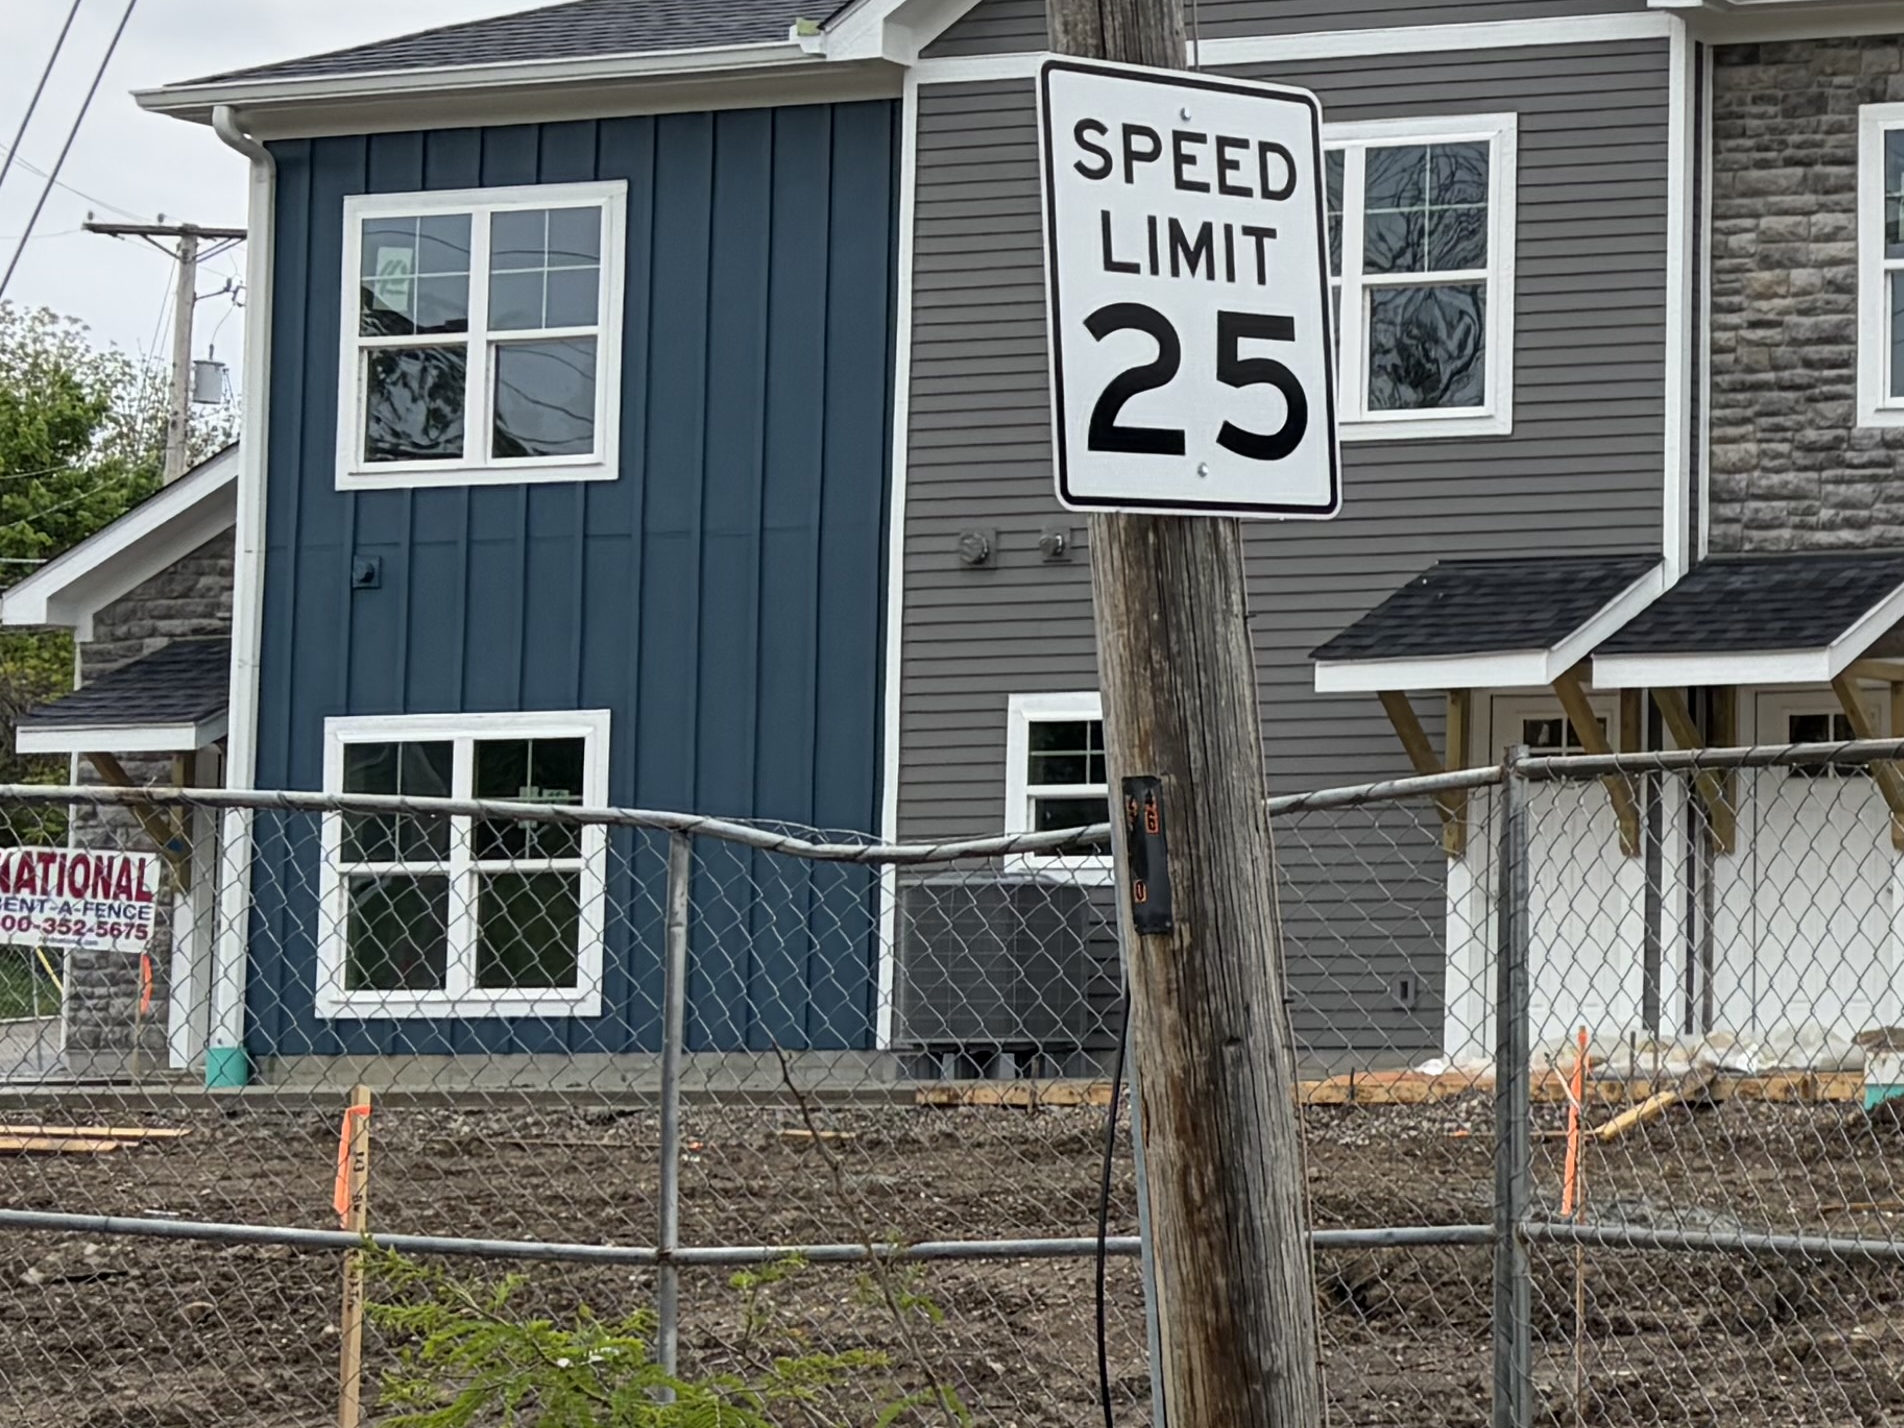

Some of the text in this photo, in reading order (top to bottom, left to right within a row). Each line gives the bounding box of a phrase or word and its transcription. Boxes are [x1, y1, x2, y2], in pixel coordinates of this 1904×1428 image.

[1074, 118, 1297, 201] SPEED
[1102, 210, 1277, 285] LIMIT
[1083, 302, 1308, 460] 25
[0, 897, 152, 921] ENT-A-FENCE
